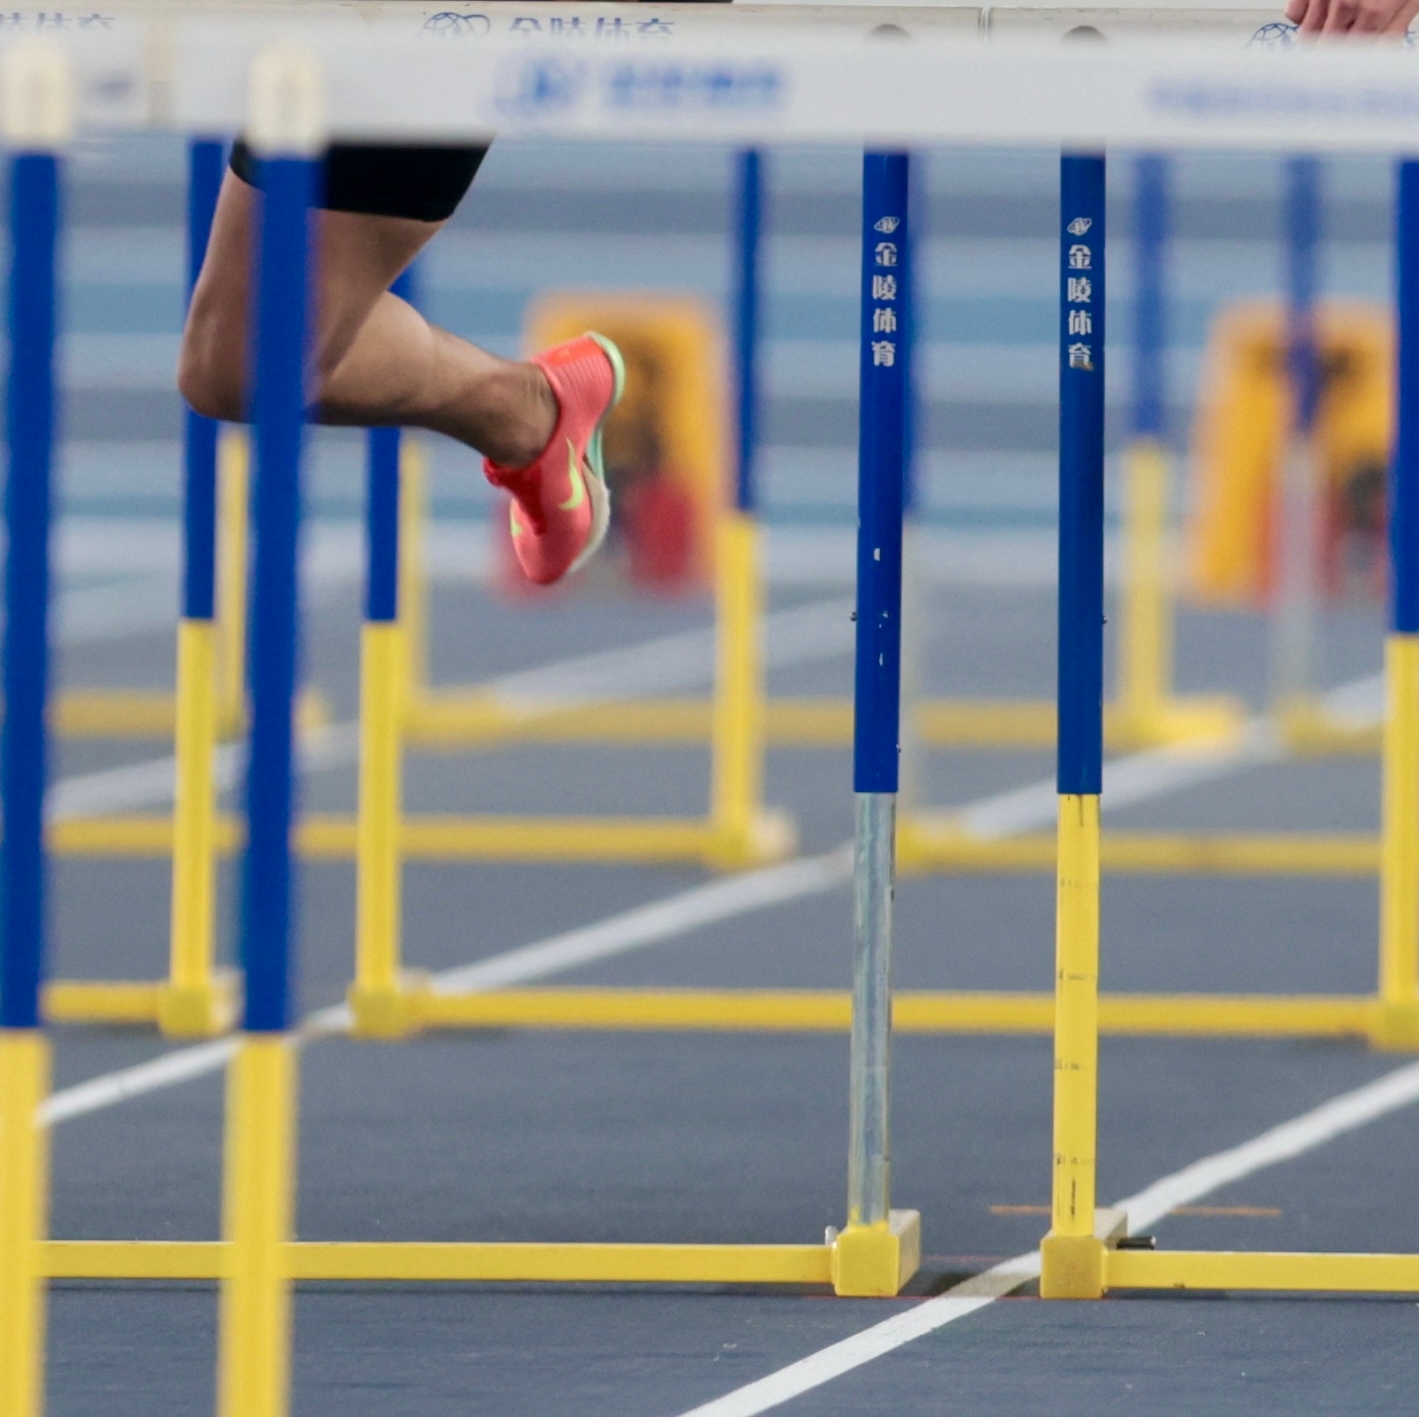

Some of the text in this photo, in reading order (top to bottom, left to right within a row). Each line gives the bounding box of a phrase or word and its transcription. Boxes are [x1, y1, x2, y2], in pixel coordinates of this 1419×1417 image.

[871, 242, 898, 367] 金陵体育
[1067, 244, 1093, 369] 金陵体育
